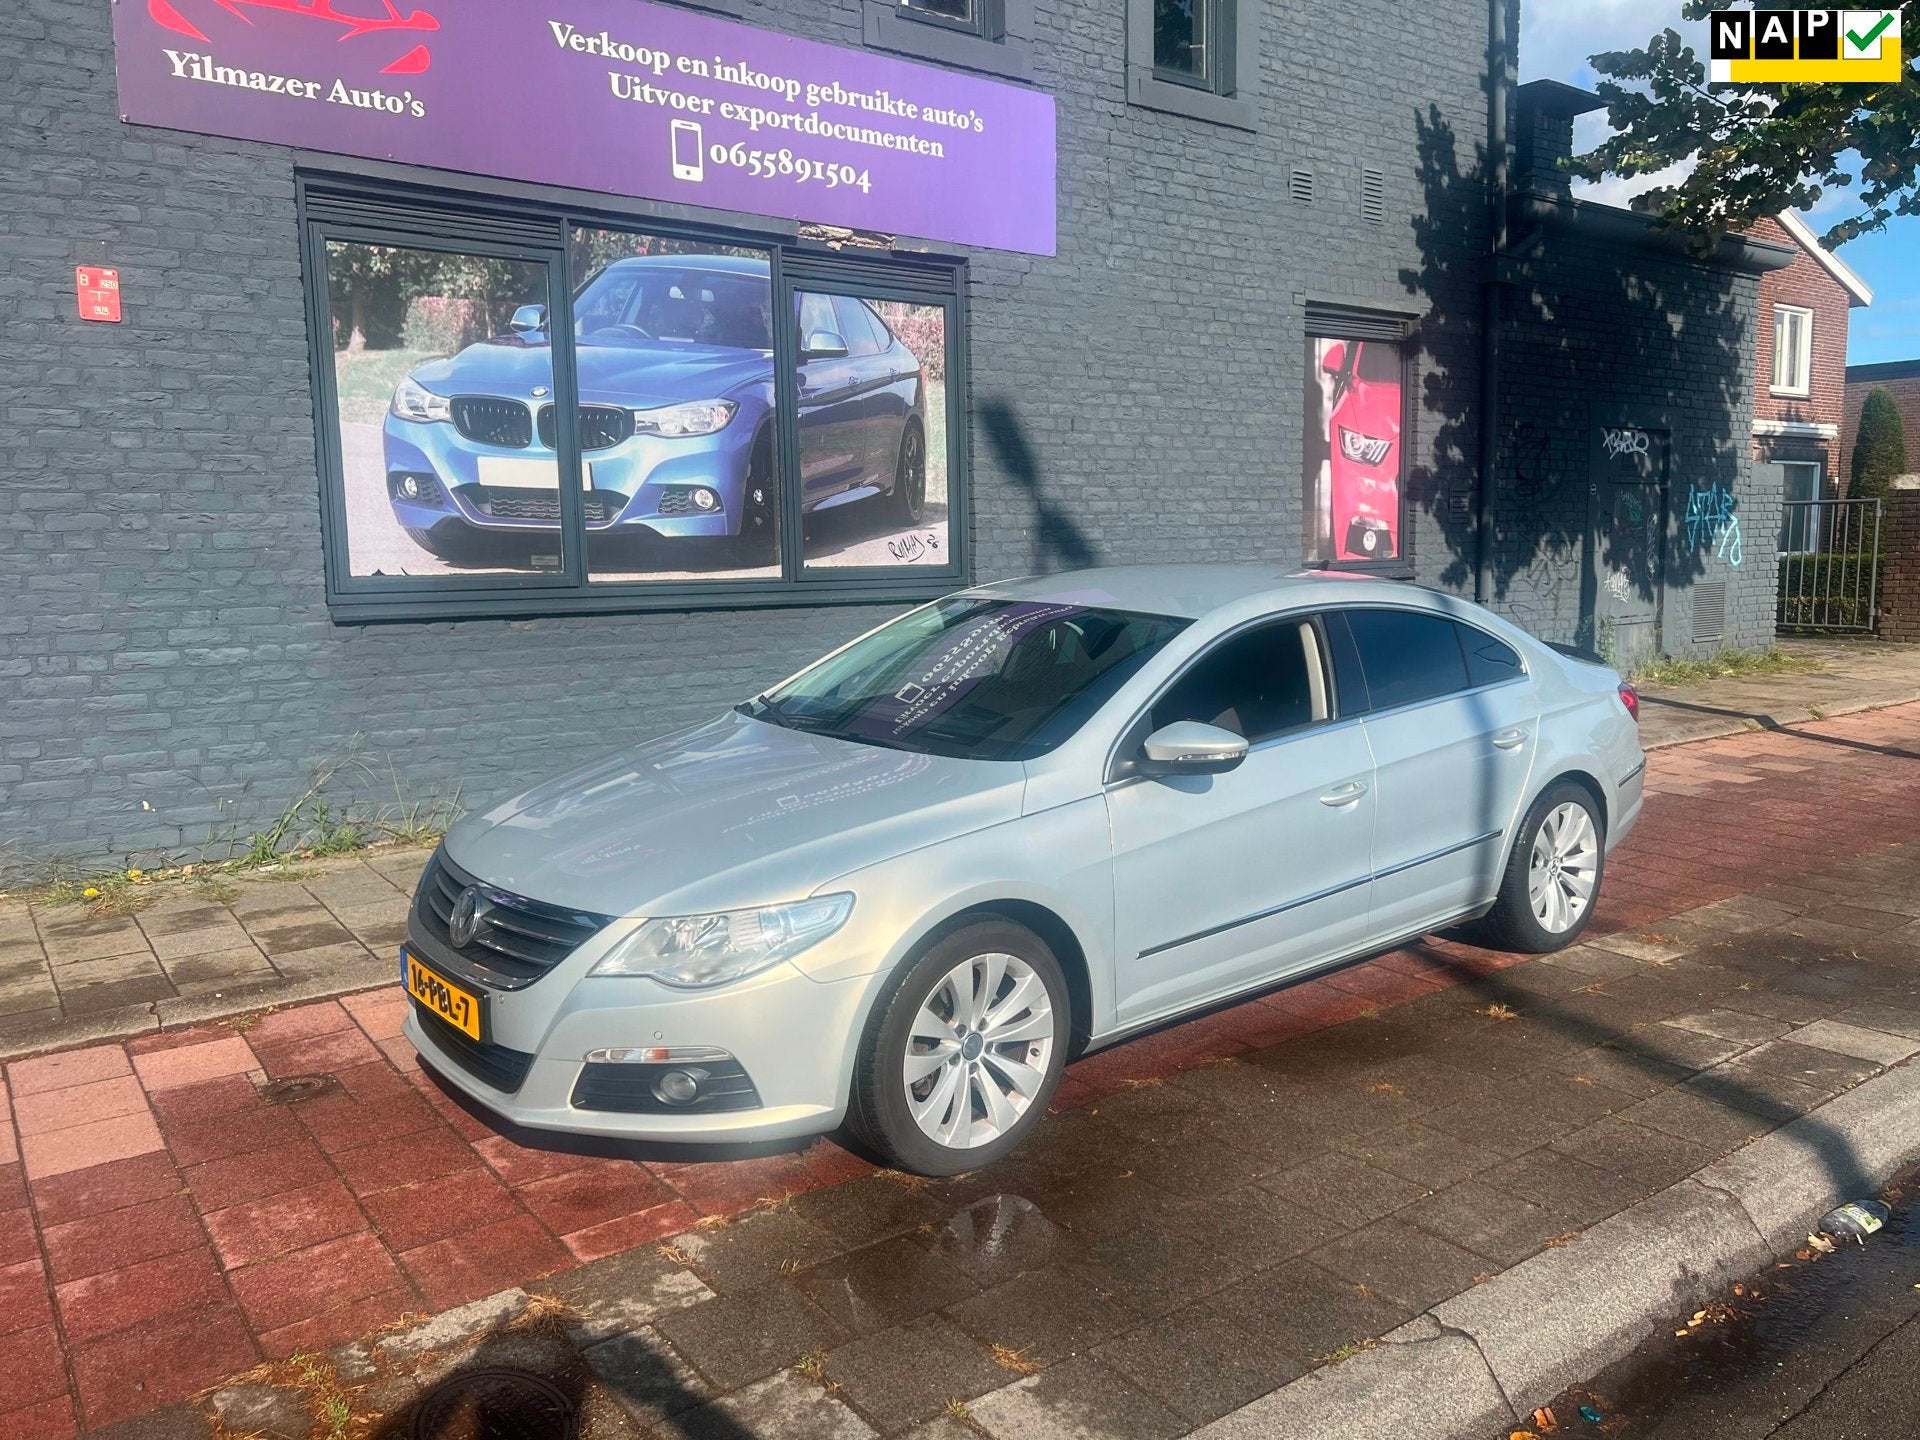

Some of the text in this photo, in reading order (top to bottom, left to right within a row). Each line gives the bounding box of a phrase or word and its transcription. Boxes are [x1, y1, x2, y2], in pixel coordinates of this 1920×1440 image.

[161, 48, 426, 118] Yilmazer Auto's
[547, 19, 985, 134] Verkoop en inkoop gebruikte auto's
[607, 71, 945, 159] Uitvoer exportdocumenten
[709, 142, 872, 194] 0655891504
[411, 963, 471, 1027] 16-PBL-7
